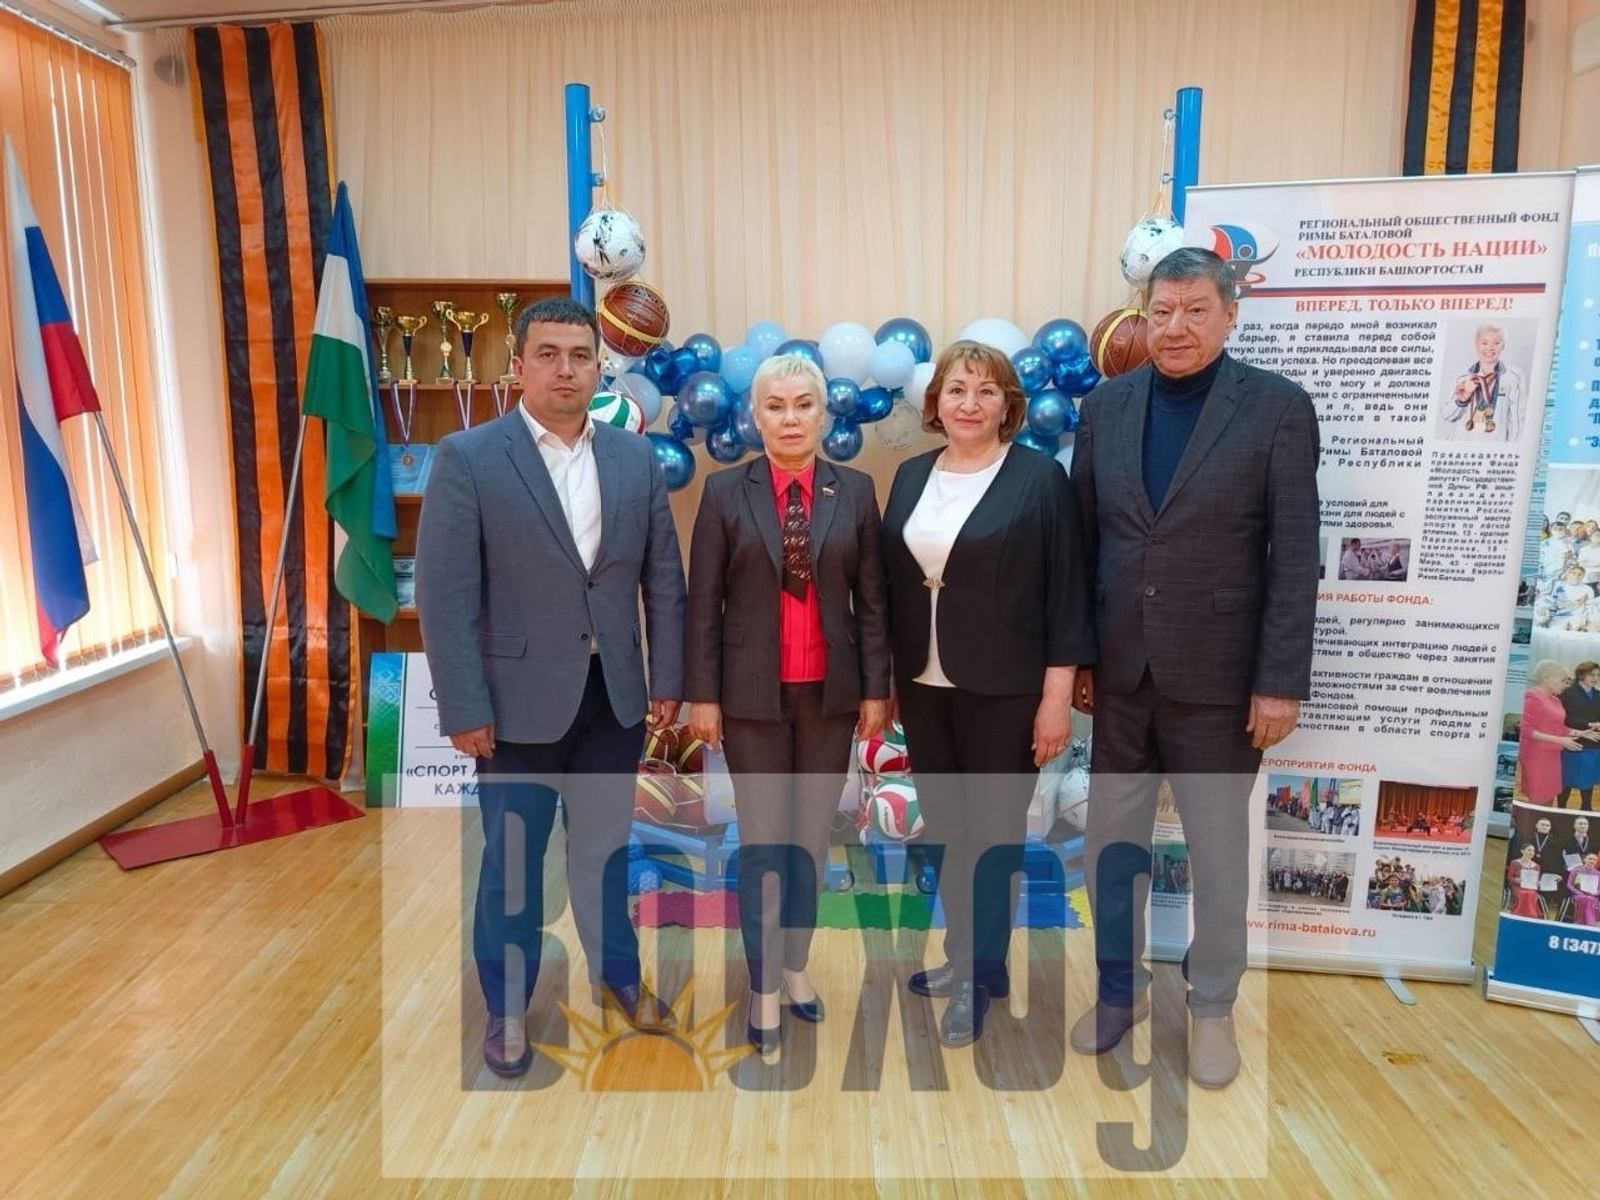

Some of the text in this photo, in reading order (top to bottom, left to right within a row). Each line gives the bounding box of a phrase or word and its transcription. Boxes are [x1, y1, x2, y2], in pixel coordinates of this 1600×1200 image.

[1300, 212, 1559, 230] РЕГИОНАЛЬНЫЙ ОБЩЕСТВЕННЫЙ ФОНД
[1299, 228, 1412, 242] РИМЫ БАТАЛОВОЙ
[1296, 240, 1548, 261] «МОЛОДОСТЬ НАЦИИ»
[1294, 264, 1483, 278] РЕСПУБЛИКИ БАШКОРТОСТАН
[1369, 299, 1435, 311] ТОЛЬКО
[1440, 297, 1514, 311] ВПЕРЕД!
[1244, 323, 1264, 332] раз,
[1270, 322, 1299, 332] когда
[1305, 322, 1344, 332] передо
[1351, 321, 1379, 330] мной
[1385, 321, 1438, 329] возникал
[1238, 332, 1280, 343] барьер,
[1304, 334, 1349, 342] ставила
[1359, 333, 1392, 343] перед
[1401, 331, 1436, 341] собой
[1258, 346, 1284, 354] цель
[1297, 345, 1377, 355] прикладывала
[1379, 345, 1398, 353] все
[1401, 345, 1434, 354] силы,
[1281, 357, 1319, 366] успеха.
[1322, 356, 1337, 365] Но
[1340, 357, 1411, 366] преодолевая
[1323, 368, 1377, 377] уверенно
[1380, 368, 1432, 377] двигаясь
[1314, 380, 1332, 388] что
[1340, 380, 1366, 389] могу
[1374, 380, 1381, 388] и
[1388, 380, 1430, 389] должна
[1341, 392, 1429, 401] ограниченными
[1343, 403, 1354, 411] я,
[1391, 413, 1427, 422] такой
[1331, 435, 1424, 445] Региональный
[1361, 447, 1423, 457] Баталовой
[1432, 451, 1520, 460] Председатель
[1338, 459, 1422, 468] Республики
[1326, 499, 1367, 508] условий
[1365, 510, 1396, 519] людей
[1336, 593, 1383, 603] РАБОТЫ
[1387, 594, 1434, 605] ФОНДА:
[1350, 617, 1406, 627] регулярно
[1415, 620, 1500, 631] занимающихся
[1382, 641, 1448, 651] интеграцию
[1451, 643, 1487, 653] людей
[1358, 650, 1410, 660] общество
[1416, 652, 1447, 662] через
[1453, 655, 1495, 664] занятия
[1311, 670, 1371, 680] активности
[1373, 672, 1419, 682] граждан
[1432, 676, 1492, 685] отношении
[1400, 685, 1423, 693] счет
[1427, 687, 1491, 696] вовлечения
[1364, 704, 1408, 714] помощи
[1415, 706, 1488, 717] профильным
[1380, 715, 1420, 725] услуги
[1430, 719, 1472, 729] людям
[1374, 724, 1421, 735] области
[1430, 729, 1470, 739] спорта
[406, 764, 467, 777] «СПОРТ
[1337, 763, 1377, 773] ФОНДА
[1549, 935, 1559, 949] 8
